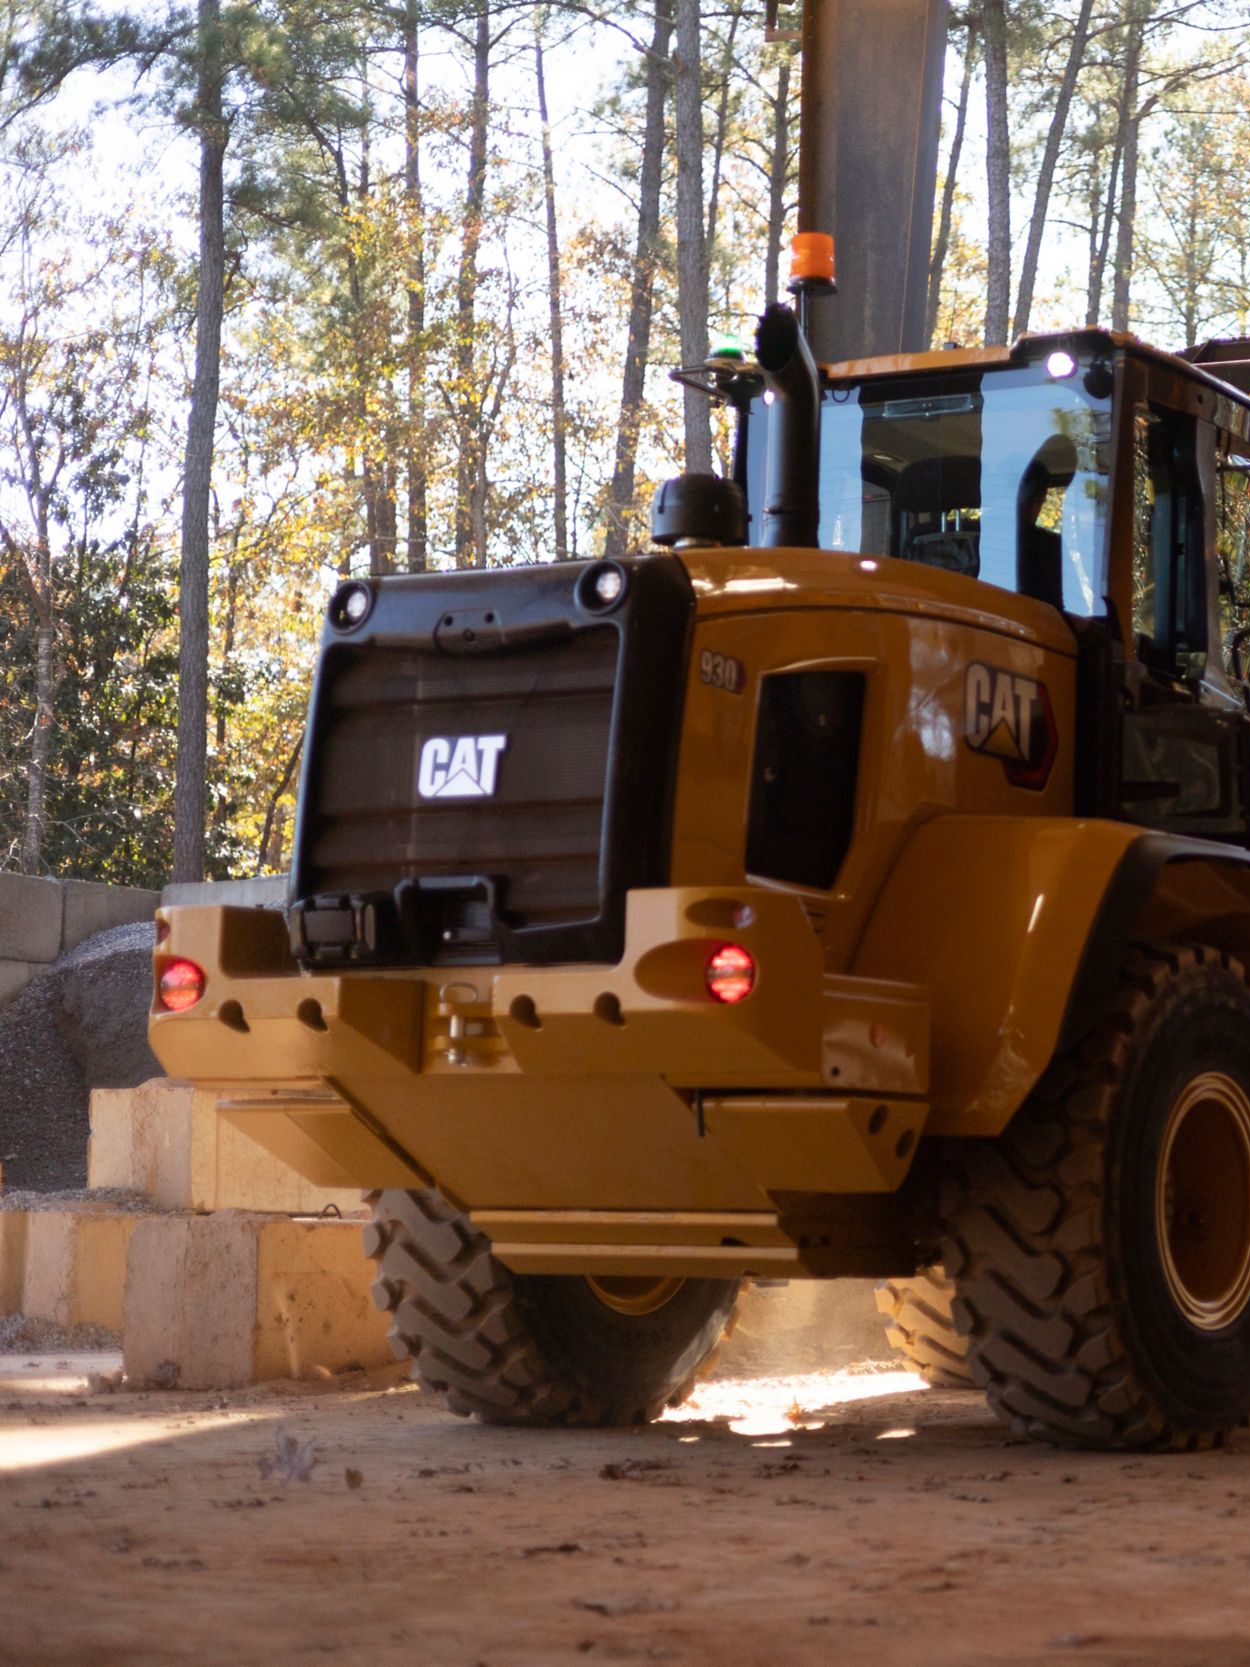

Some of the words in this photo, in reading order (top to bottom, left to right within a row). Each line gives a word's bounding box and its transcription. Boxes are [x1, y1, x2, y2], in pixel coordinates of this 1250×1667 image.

[701, 651, 737, 690] 930
[965, 664, 1038, 761] CAT
[418, 735, 506, 798] CAT
